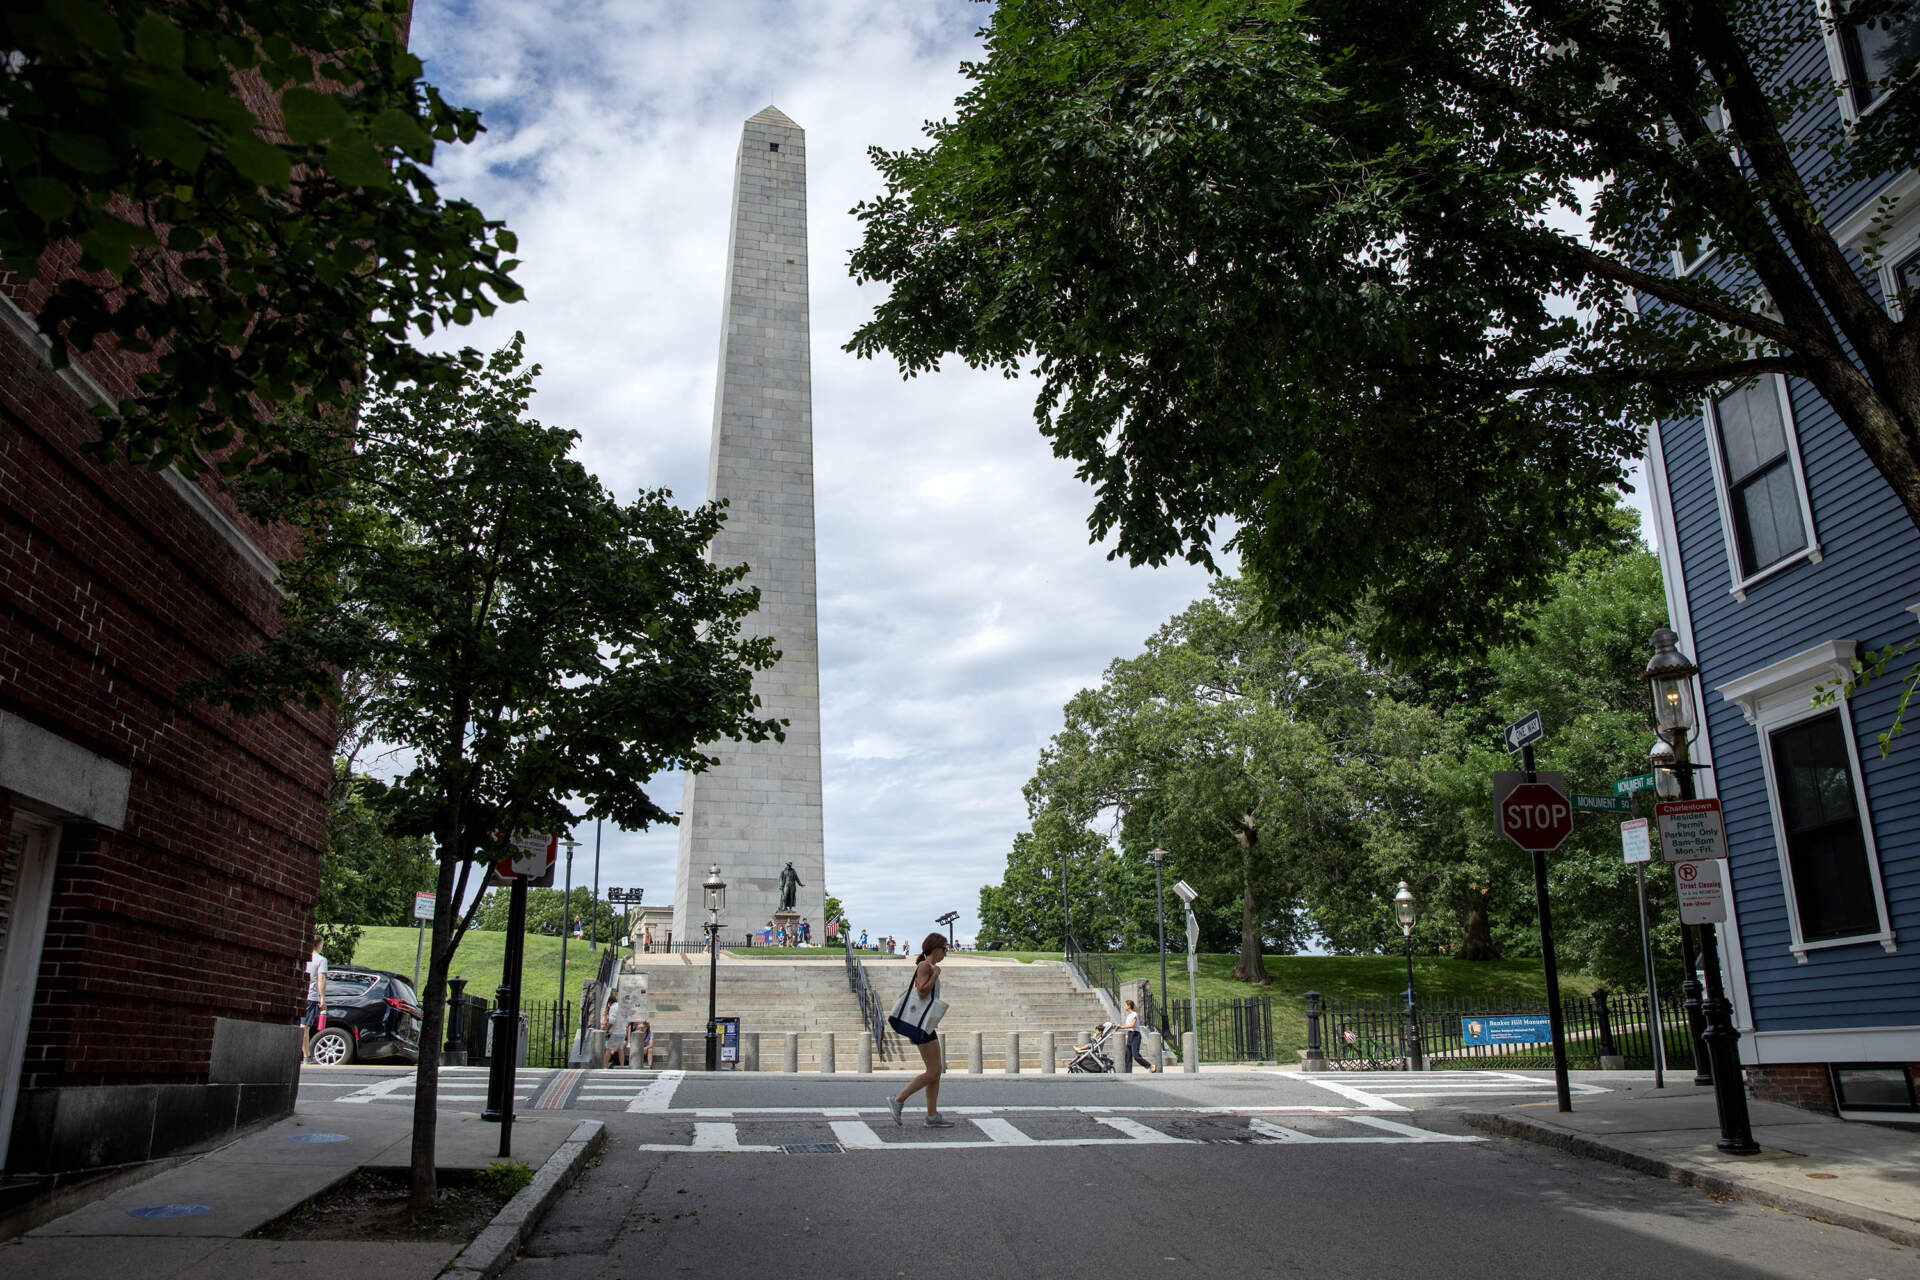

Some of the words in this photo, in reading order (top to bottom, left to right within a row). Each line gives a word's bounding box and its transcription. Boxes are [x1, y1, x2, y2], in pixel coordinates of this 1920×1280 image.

[1516, 727, 1526, 740] ONE
[1528, 719, 1539, 734] WAY
[1617, 777, 1644, 793] MONUMENT
[1577, 794, 1616, 809] MONUMENT
[1621, 800, 1630, 809] SQ
[1663, 803, 1712, 813] Charlestown
[1507, 804, 1567, 830] STOP
[1670, 812, 1708, 821] Resident
[1664, 830, 1697, 839] Parking
[1699, 827, 1718, 837] Only
[1679, 882, 1697, 890] Street
[1698, 881, 1721, 889] Cleaning
[1511, 1019, 1523, 1027] Hill
